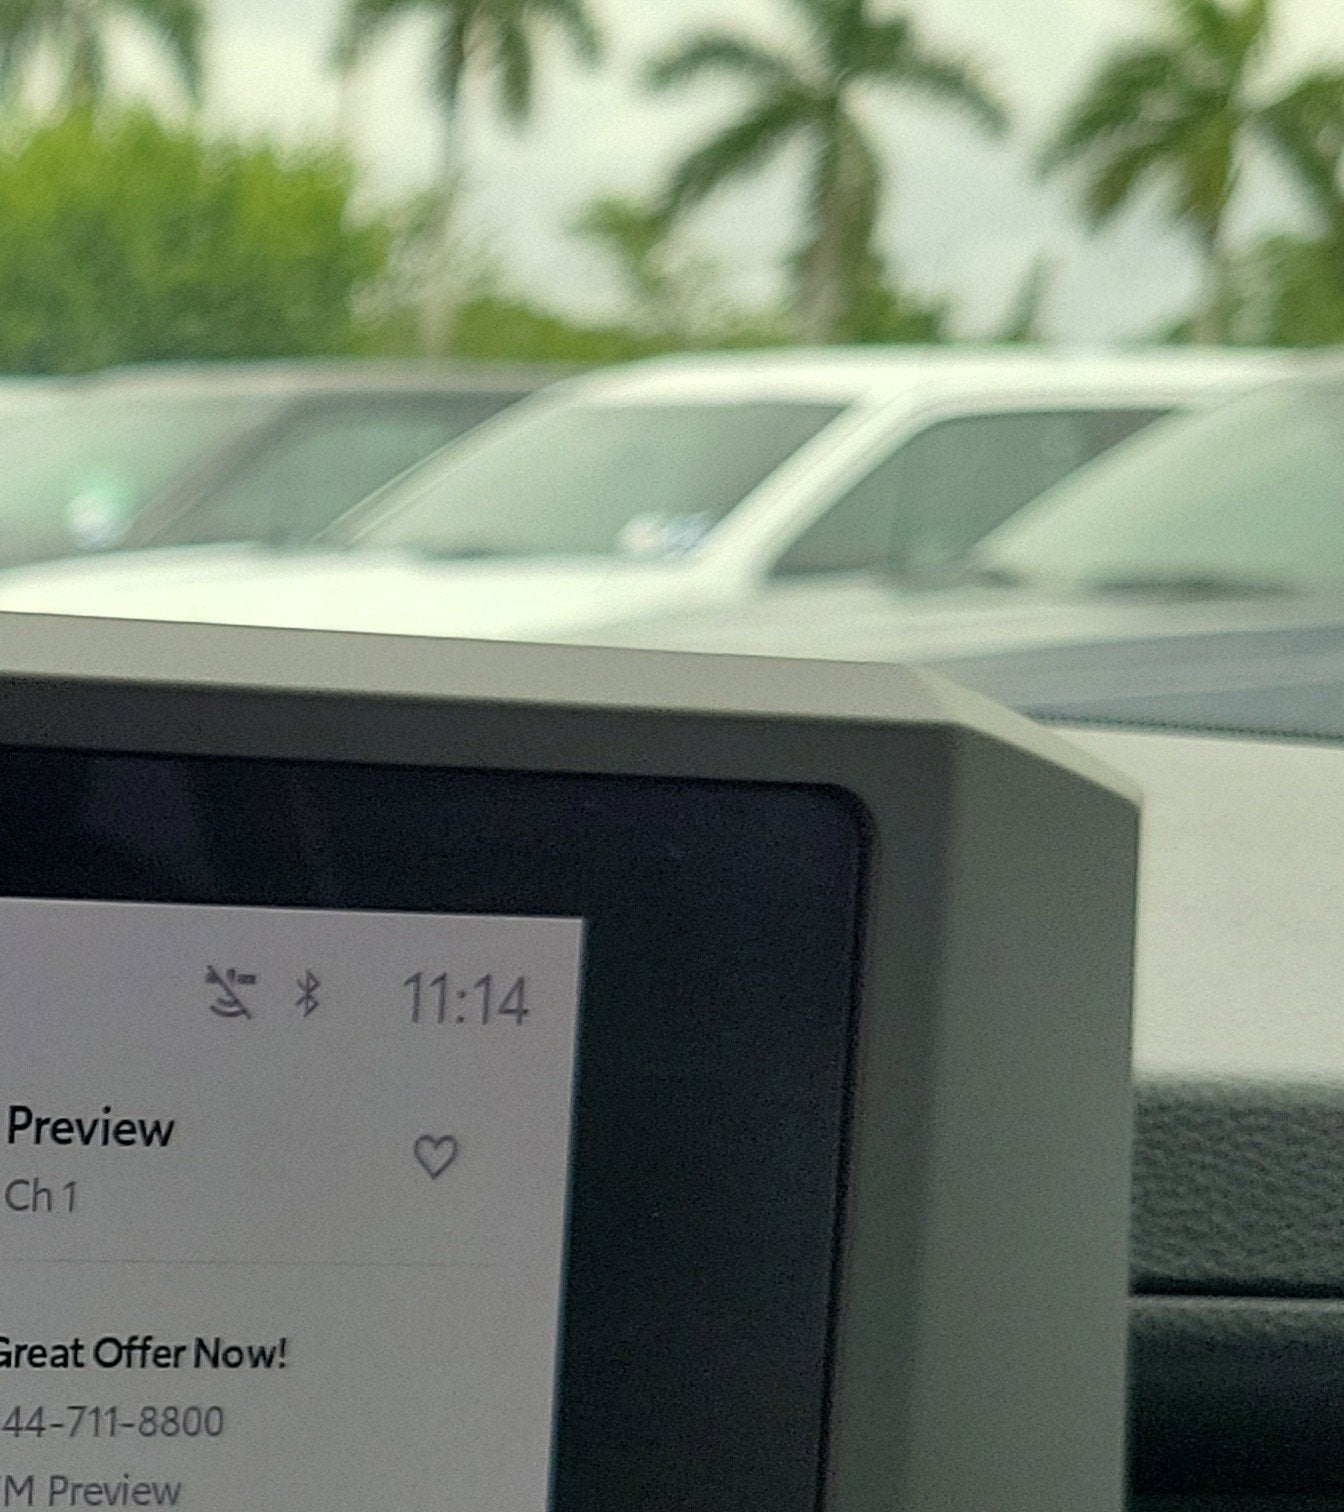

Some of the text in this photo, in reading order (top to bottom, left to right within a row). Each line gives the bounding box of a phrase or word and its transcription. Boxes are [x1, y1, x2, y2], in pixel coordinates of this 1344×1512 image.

[402, 970, 532, 1027] 11:14
[7, 1104, 176, 1148] Preview
[3, 1176, 54, 1214] Ch
[62, 1180, 79, 1214] 1
[92, 1334, 188, 1370] Offer
[192, 1336, 288, 1370] Now!
[47, 1472, 182, 1508] Preview
